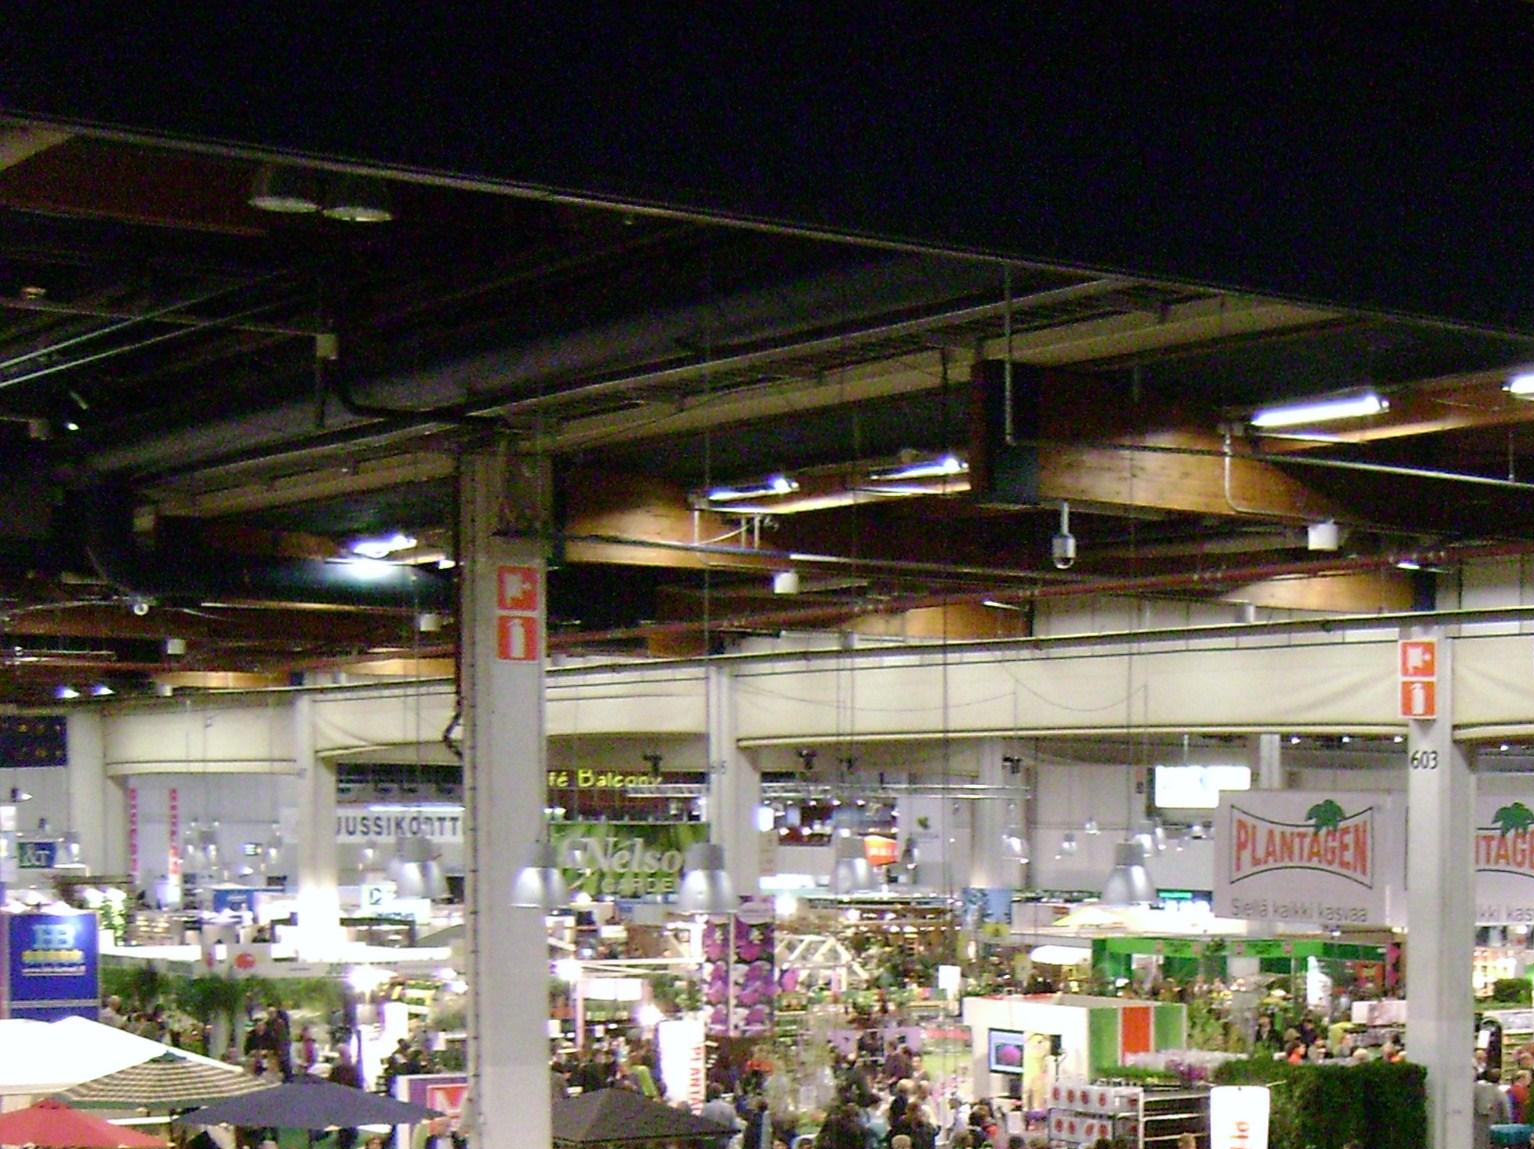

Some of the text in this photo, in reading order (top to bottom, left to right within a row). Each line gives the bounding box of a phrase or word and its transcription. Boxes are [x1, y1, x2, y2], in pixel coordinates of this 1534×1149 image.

[1410, 750, 1439, 770] 603
[547, 769, 663, 788] fé Balcony
[336, 815, 460, 837] USSIKOTT
[562, 836, 684, 874] Nelso
[1234, 817, 1368, 877] PLANTAGEN
[601, 877, 675, 893] GARDE
